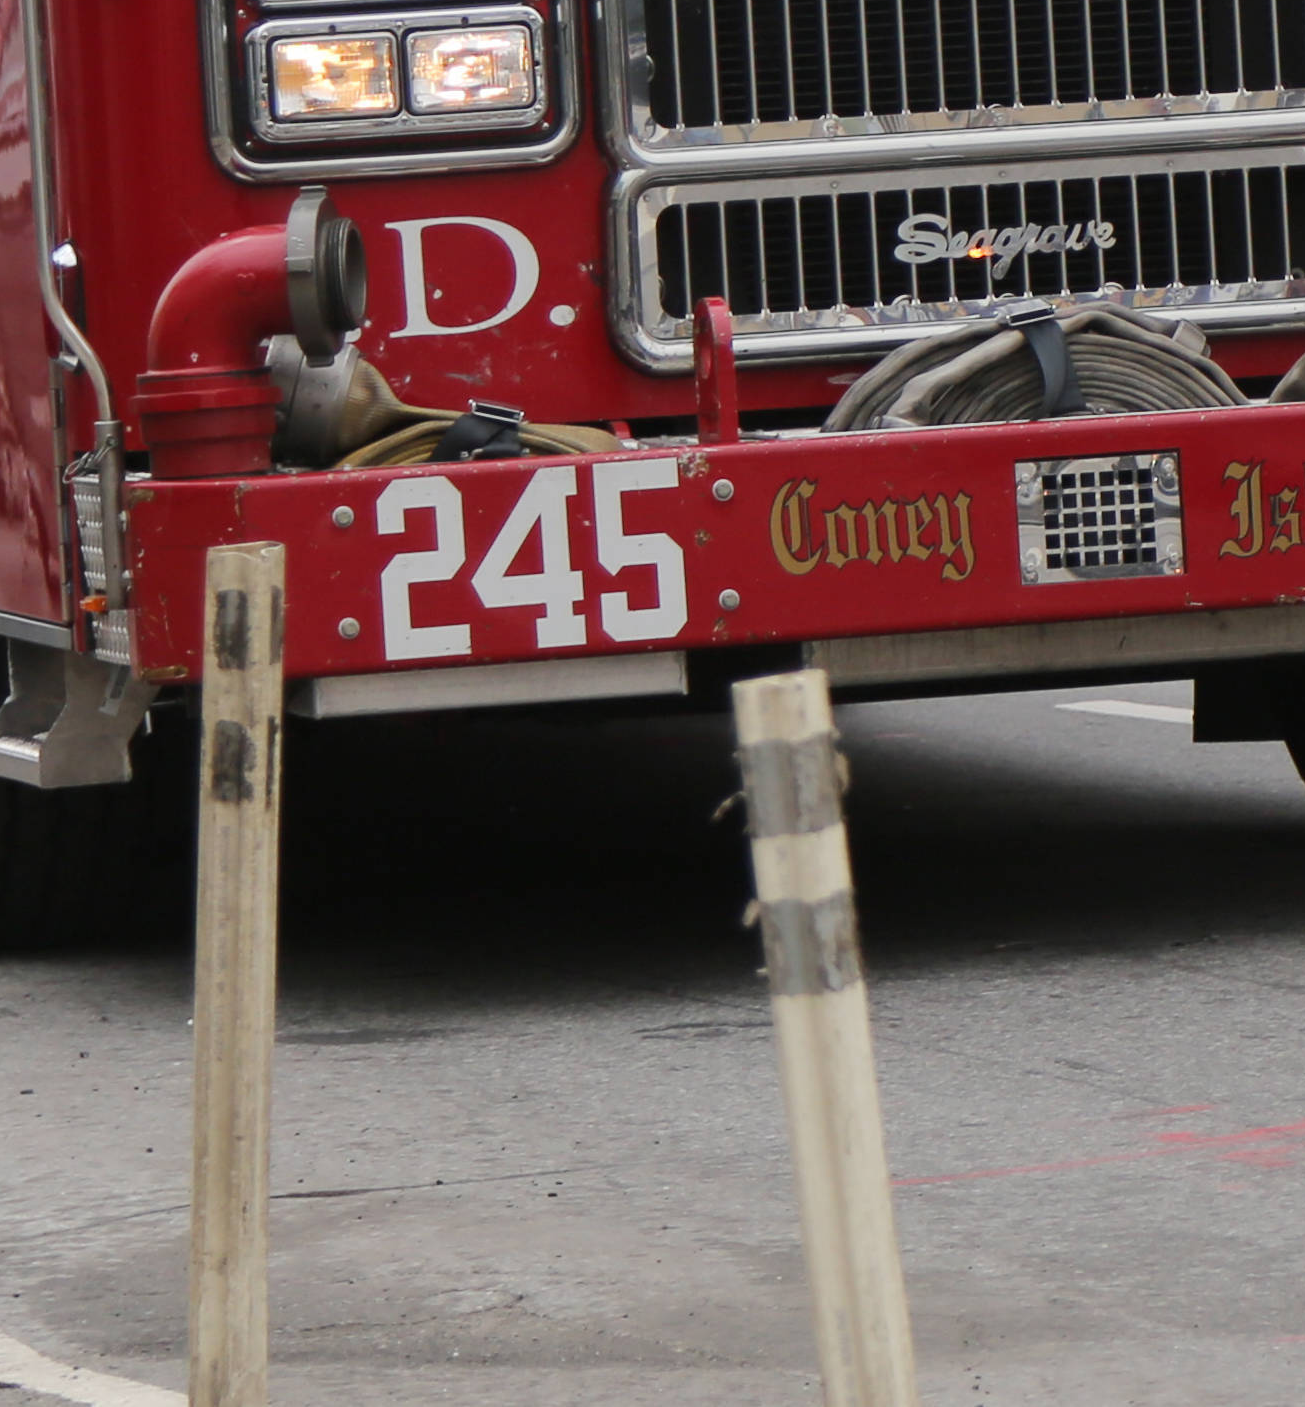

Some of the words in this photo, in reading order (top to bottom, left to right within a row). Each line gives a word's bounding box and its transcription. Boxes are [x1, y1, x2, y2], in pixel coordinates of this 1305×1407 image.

[893, 212, 1118, 281] Seagrave
[375, 456, 689, 661] 245
[768, 476, 977, 582] Coney
